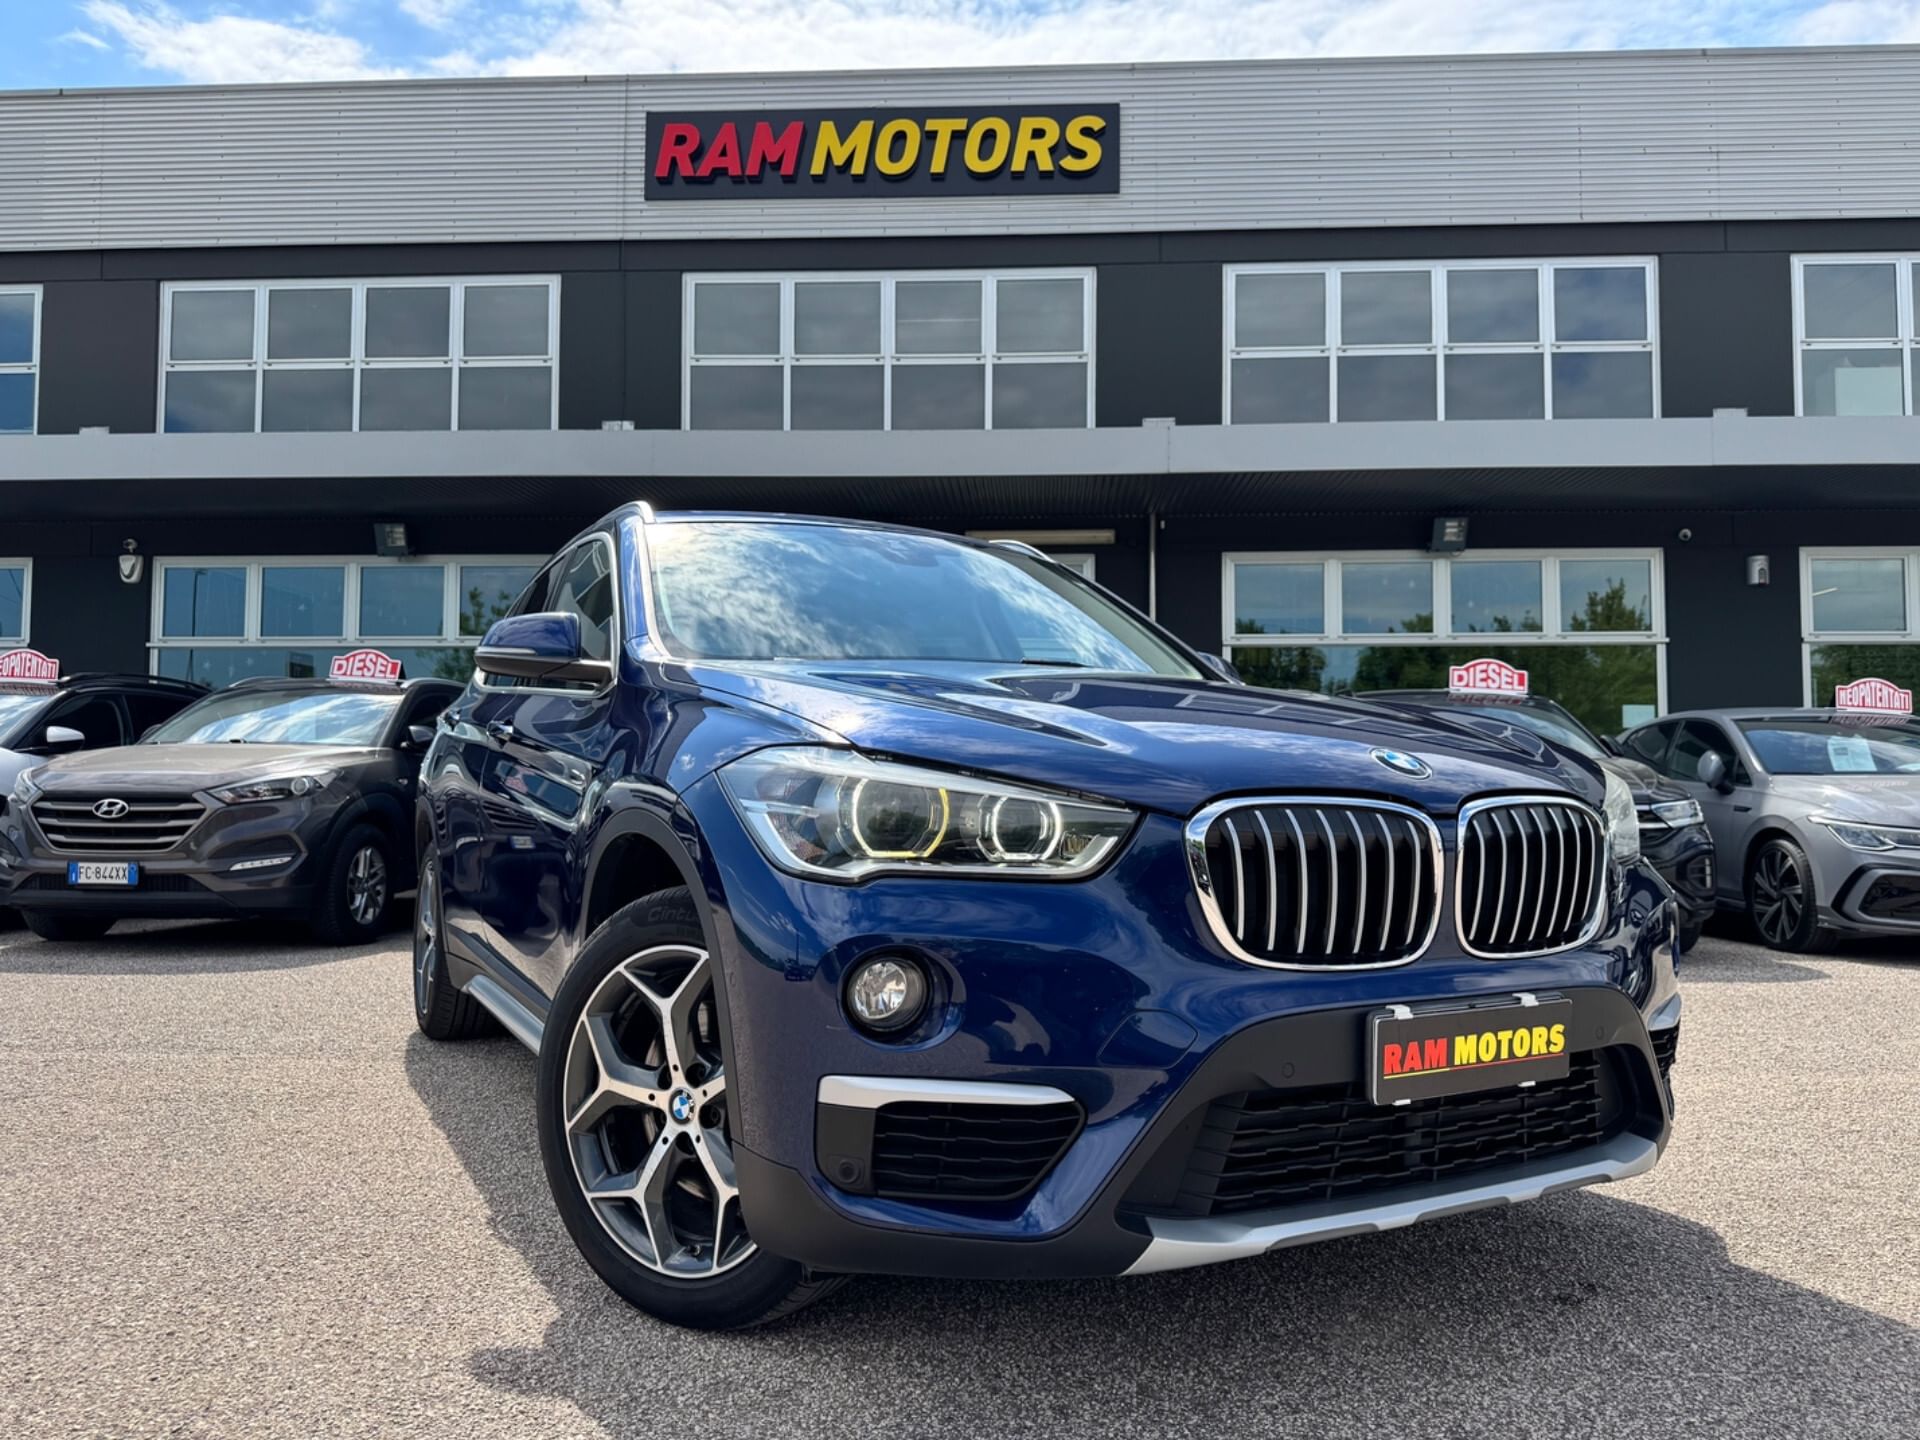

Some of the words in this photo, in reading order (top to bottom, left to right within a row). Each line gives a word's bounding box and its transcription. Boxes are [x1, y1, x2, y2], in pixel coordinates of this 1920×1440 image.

[654, 120, 805, 178] RAM
[808, 115, 1107, 177] MOTORS
[332, 653, 396, 678] DIESEL
[1453, 663, 1524, 690] DIESEL
[1840, 681, 1909, 710] NEOPATENTATI
[1383, 1037, 1448, 1075] RAM
[1454, 1023, 1566, 1066] MOTORS
